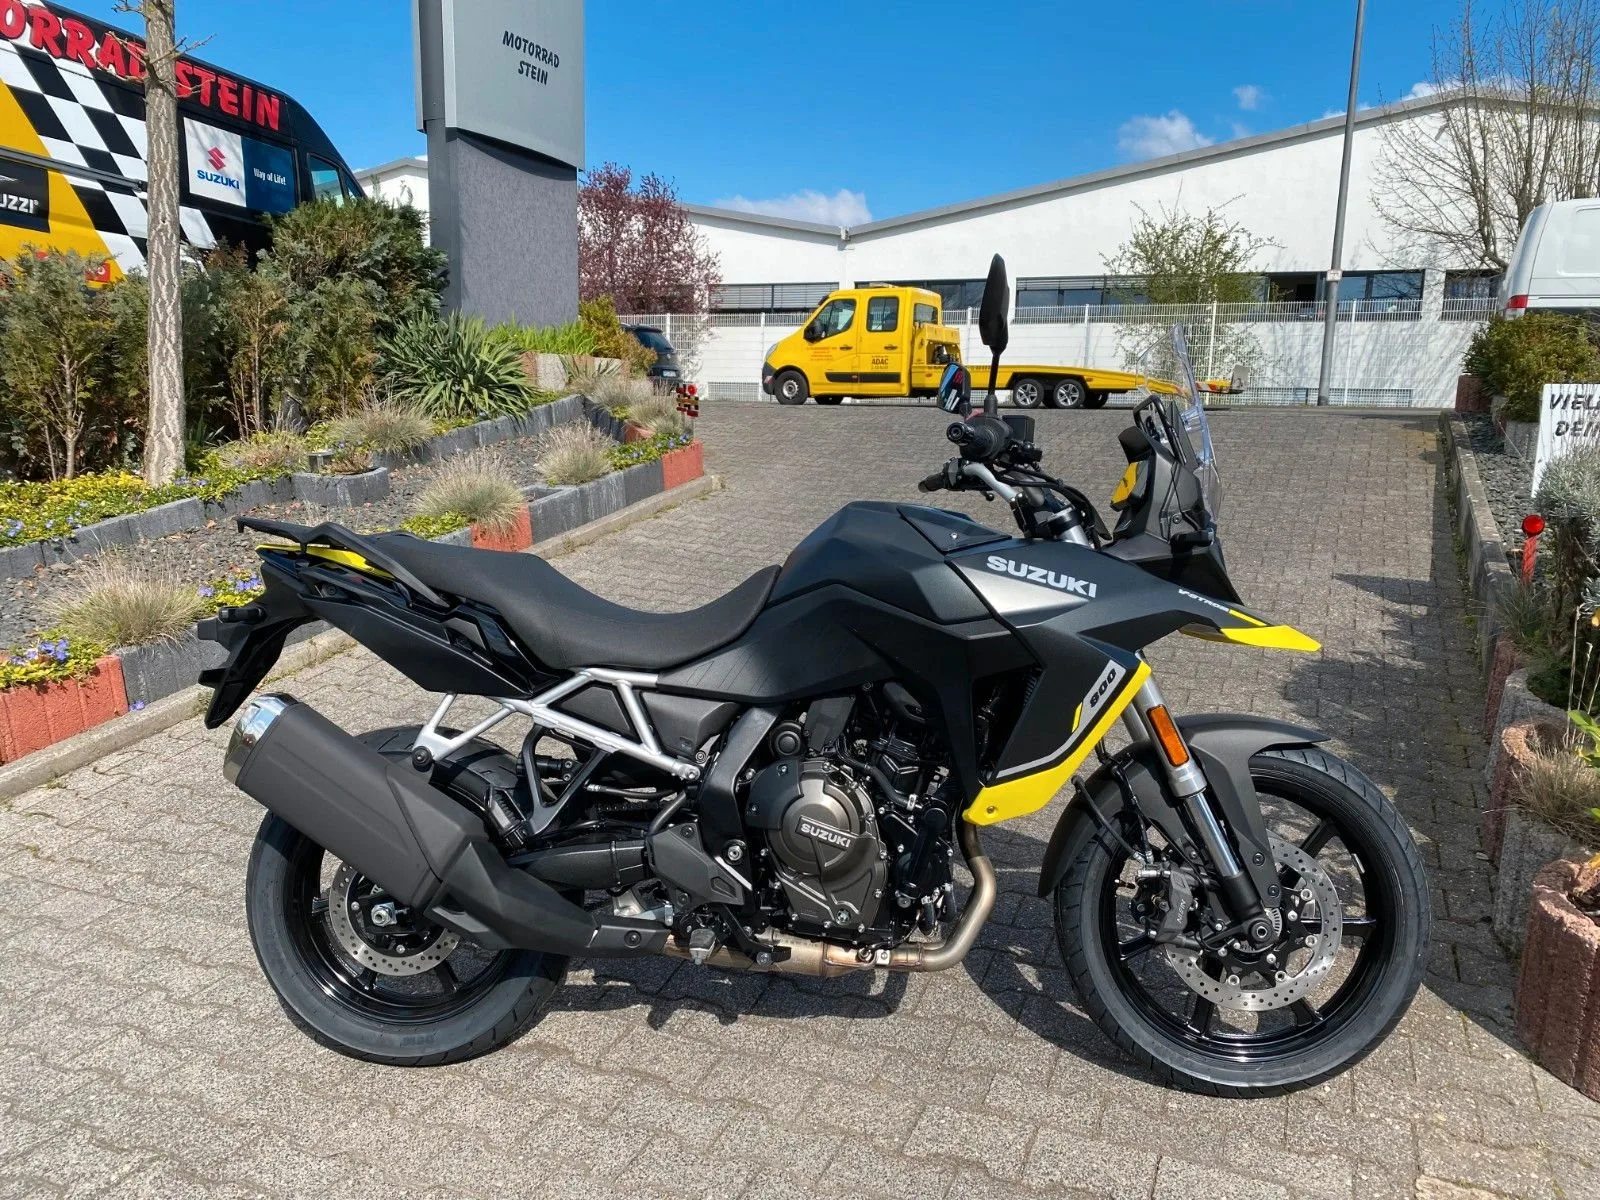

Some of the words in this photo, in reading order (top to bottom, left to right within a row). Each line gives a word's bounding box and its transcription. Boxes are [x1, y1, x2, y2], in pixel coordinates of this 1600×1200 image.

[502, 30, 560, 68] MOTORRAD
[518, 60, 548, 85] STEIN
[174, 60, 280, 131] STEIN
[196, 169, 240, 190] SUZUKI
[253, 167, 266, 181] Way
[267, 172, 274, 182] of
[273, 174, 287, 186] Life!
[1550, 393, 1600, 410] VIEL
[986, 555, 1098, 599] SUZUKI
[1090, 667, 1117, 708] 800
[800, 823, 851, 848] SUZUKI
